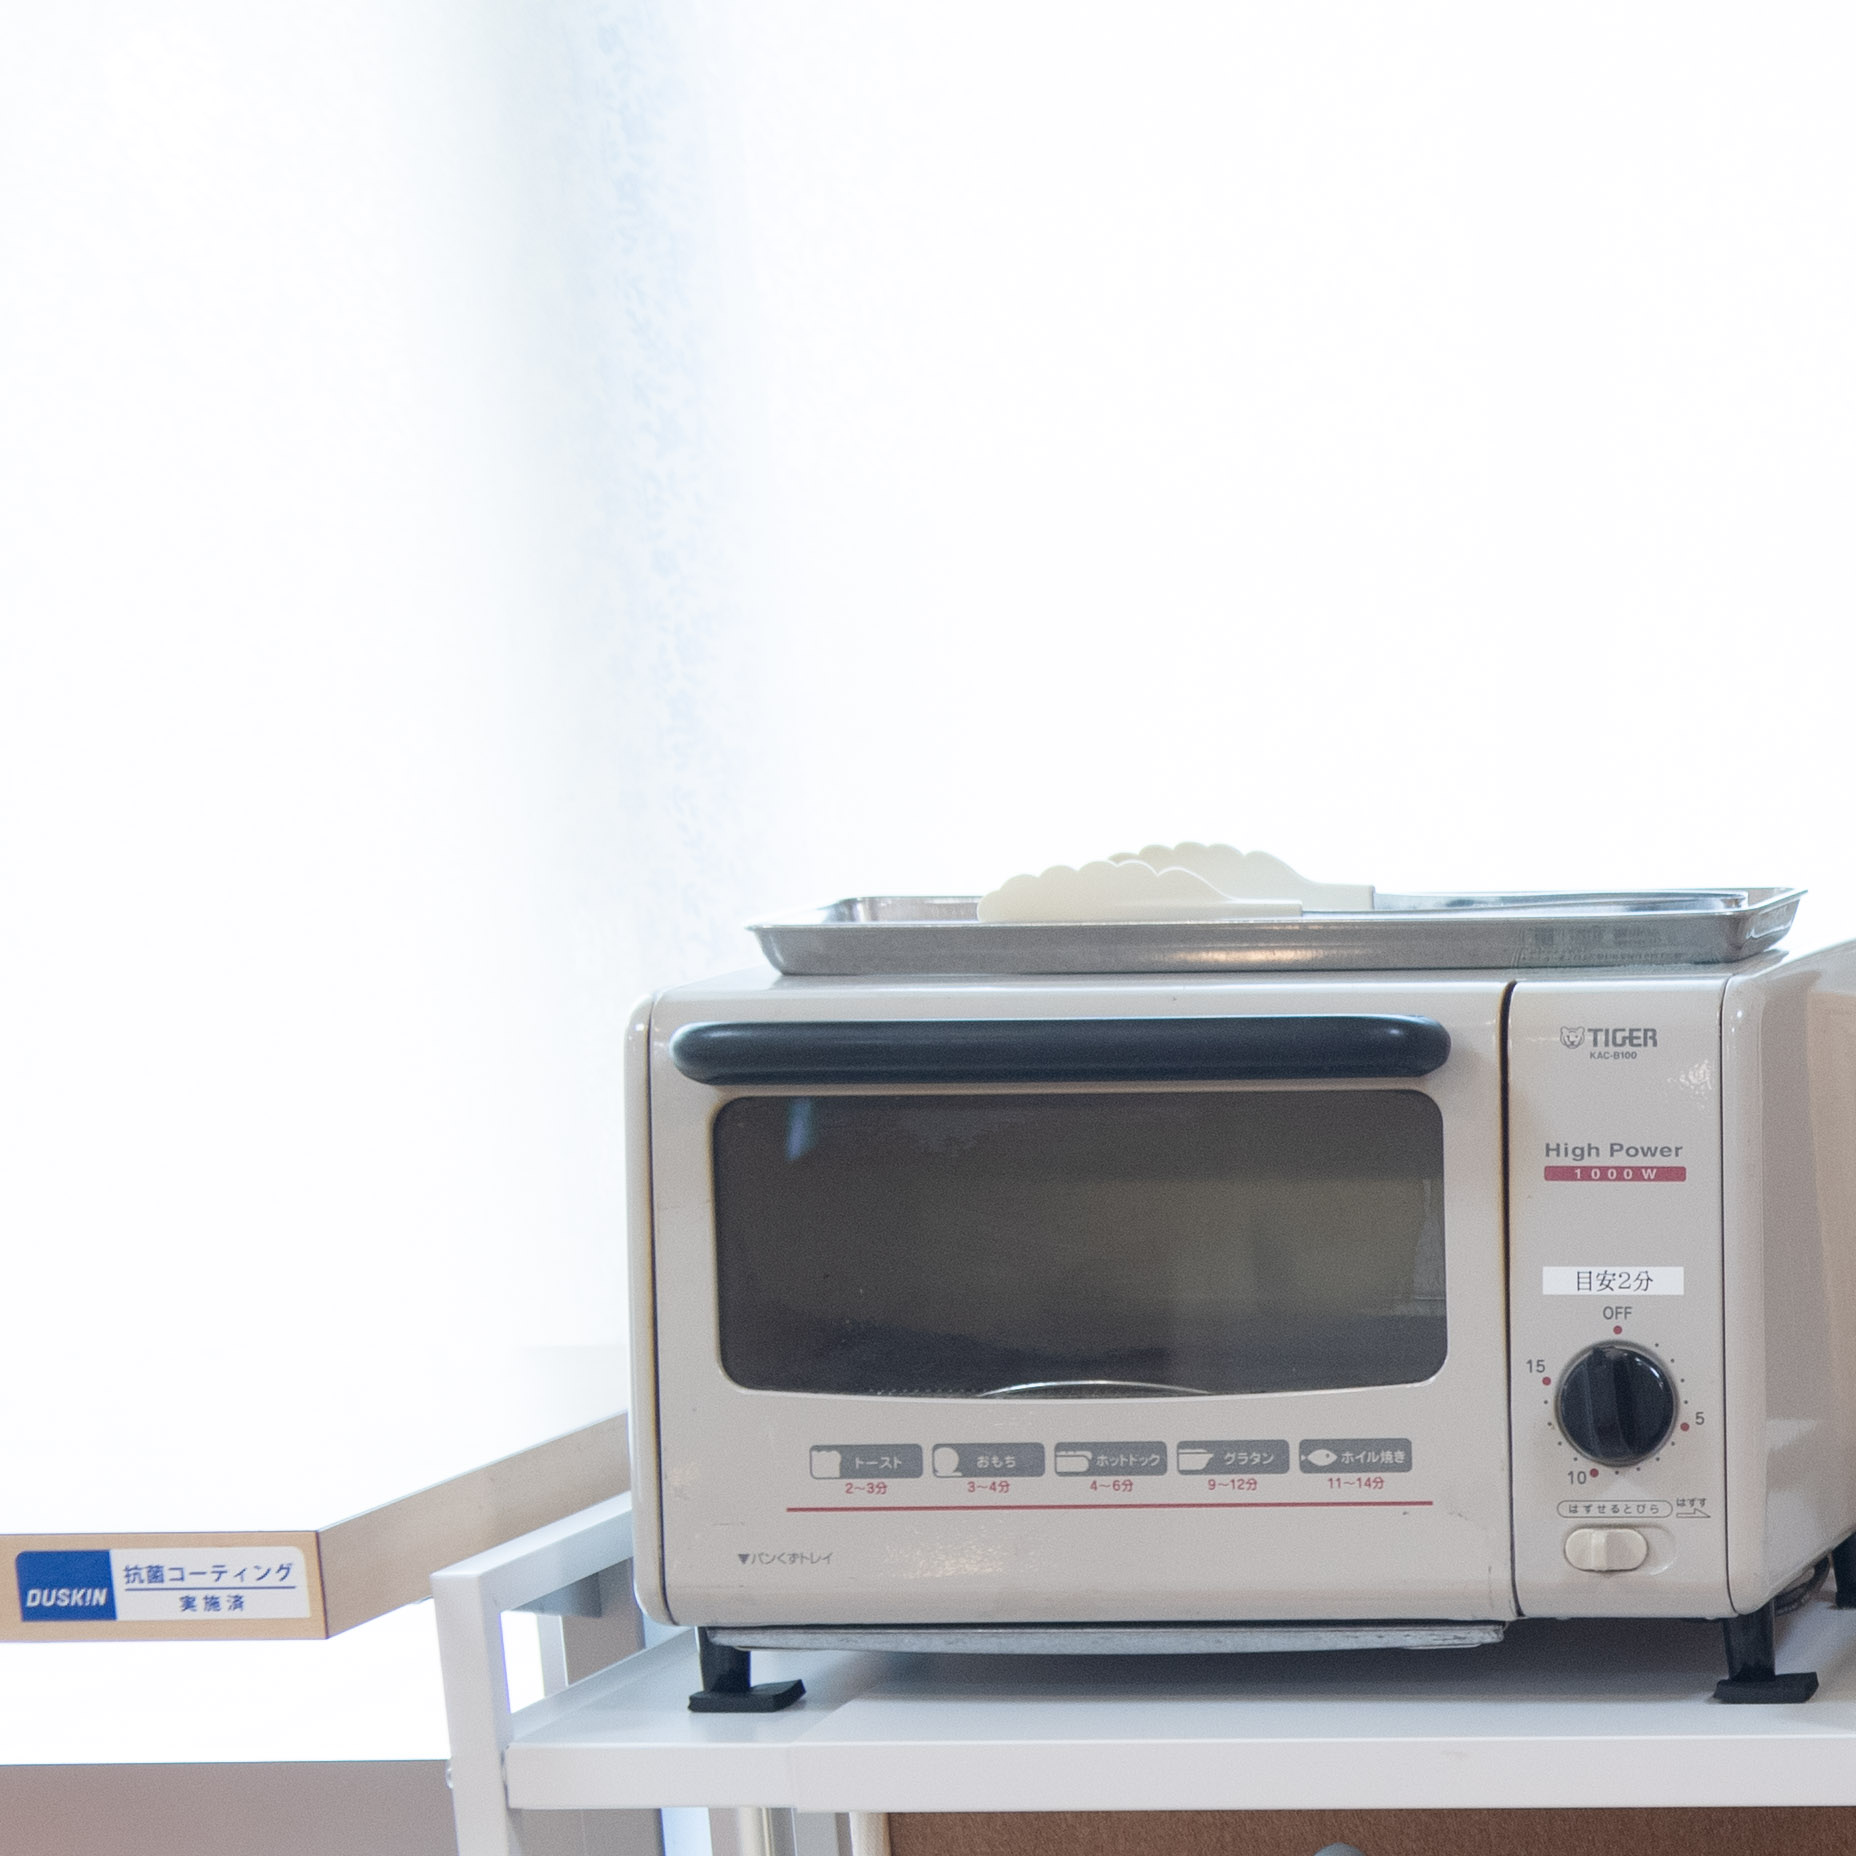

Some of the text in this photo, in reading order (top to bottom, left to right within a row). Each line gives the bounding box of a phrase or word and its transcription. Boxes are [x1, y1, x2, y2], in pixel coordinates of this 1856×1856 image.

[1587, 1028, 1658, 1048] TIGER
[1589, 1050, 1638, 1060] KAC-B100
[1544, 1142, 1684, 1161] High Power
[1576, 1270, 1654, 1292] 目安2分
[1602, 1306, 1633, 1321] OFF
[1526, 1359, 1546, 1374] 15
[1694, 1411, 1705, 1426] 5
[854, 1455, 903, 1470] トースト
[976, 1455, 1017, 1470] おもち
[1223, 1450, 1275, 1466] グラタン
[1340, 1450, 1406, 1465] ホイル焼き
[1567, 1470, 1587, 1485] 10
[1568, 1503, 1660, 1515] はずせるとびら
[1676, 1497, 1707, 1508] はずす
[123, 1562, 294, 1584] 抗菌コーティング
[26, 1587, 108, 1608] DUSKIN
[179, 1594, 245, 1613] 実施済
